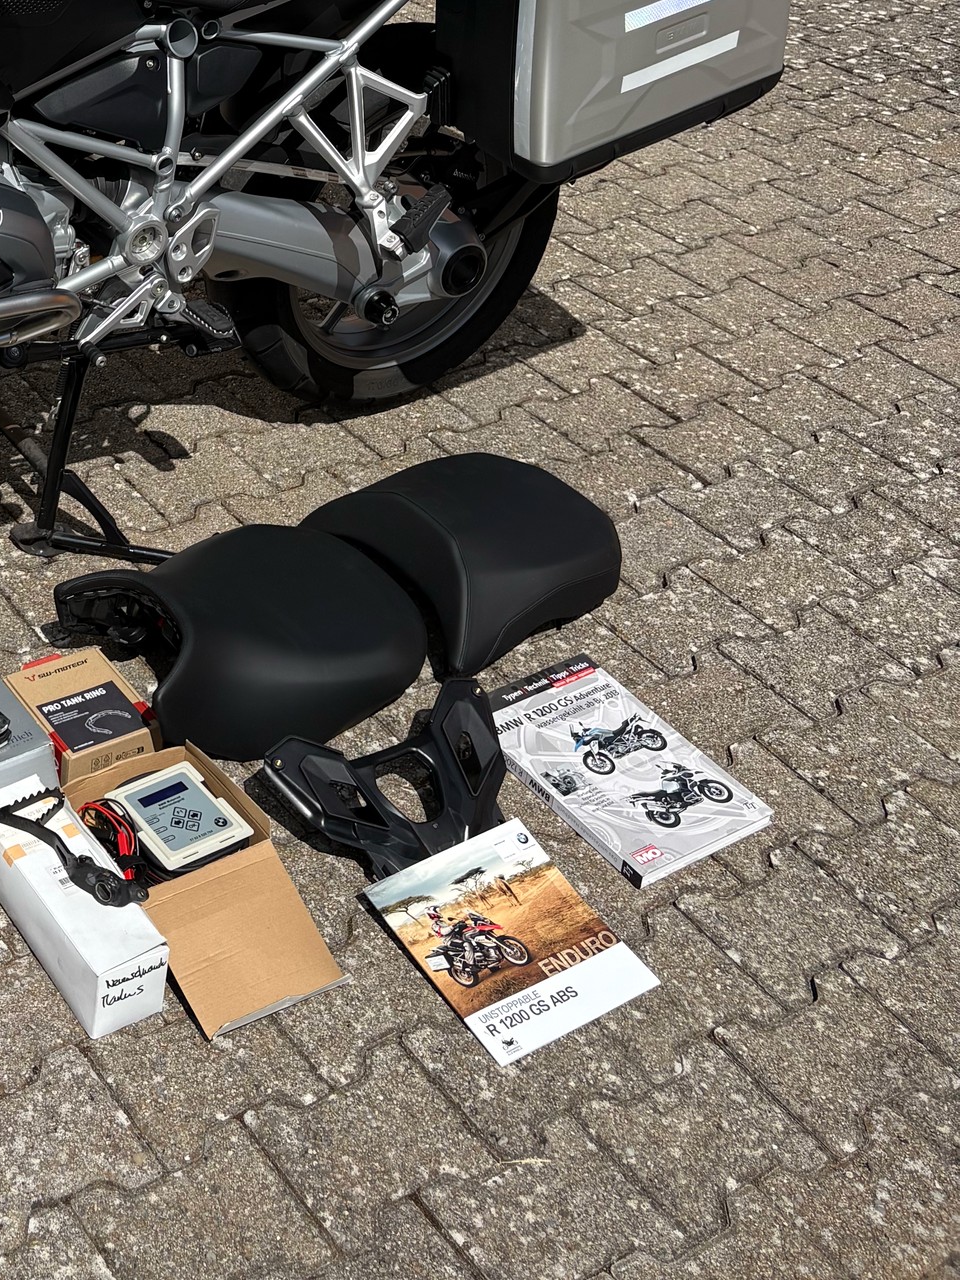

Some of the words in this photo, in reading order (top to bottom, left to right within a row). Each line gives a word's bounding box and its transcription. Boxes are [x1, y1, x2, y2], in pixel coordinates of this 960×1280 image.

[42, 703, 61, 714] PRO
[61, 695, 85, 709] TANK
[83, 687, 107, 701] RING
[502, 690, 522, 702] Typen
[524, 678, 550, 691] Technik
[550, 671, 570, 681] Tipps
[569, 662, 590, 673] Tricks
[524, 712, 533, 722] R
[532, 703, 559, 719] 1200
[557, 695, 574, 708] GS
[574, 682, 611, 702] Adventure
[535, 704, 584, 729] wassergekühlt
[585, 700, 595, 709] ab
[604, 689, 620, 701] 2013
[528, 778, 551, 803] BMW
[636, 848, 663, 865] MO
[538, 930, 618, 977] ENDURO
[478, 989, 542, 1024] UNSTOPPABLE
[485, 1023, 501, 1037] R
[499, 1009, 531, 1030] 1200
[529, 999, 551, 1016] GS
[549, 986, 579, 1008] ABS
